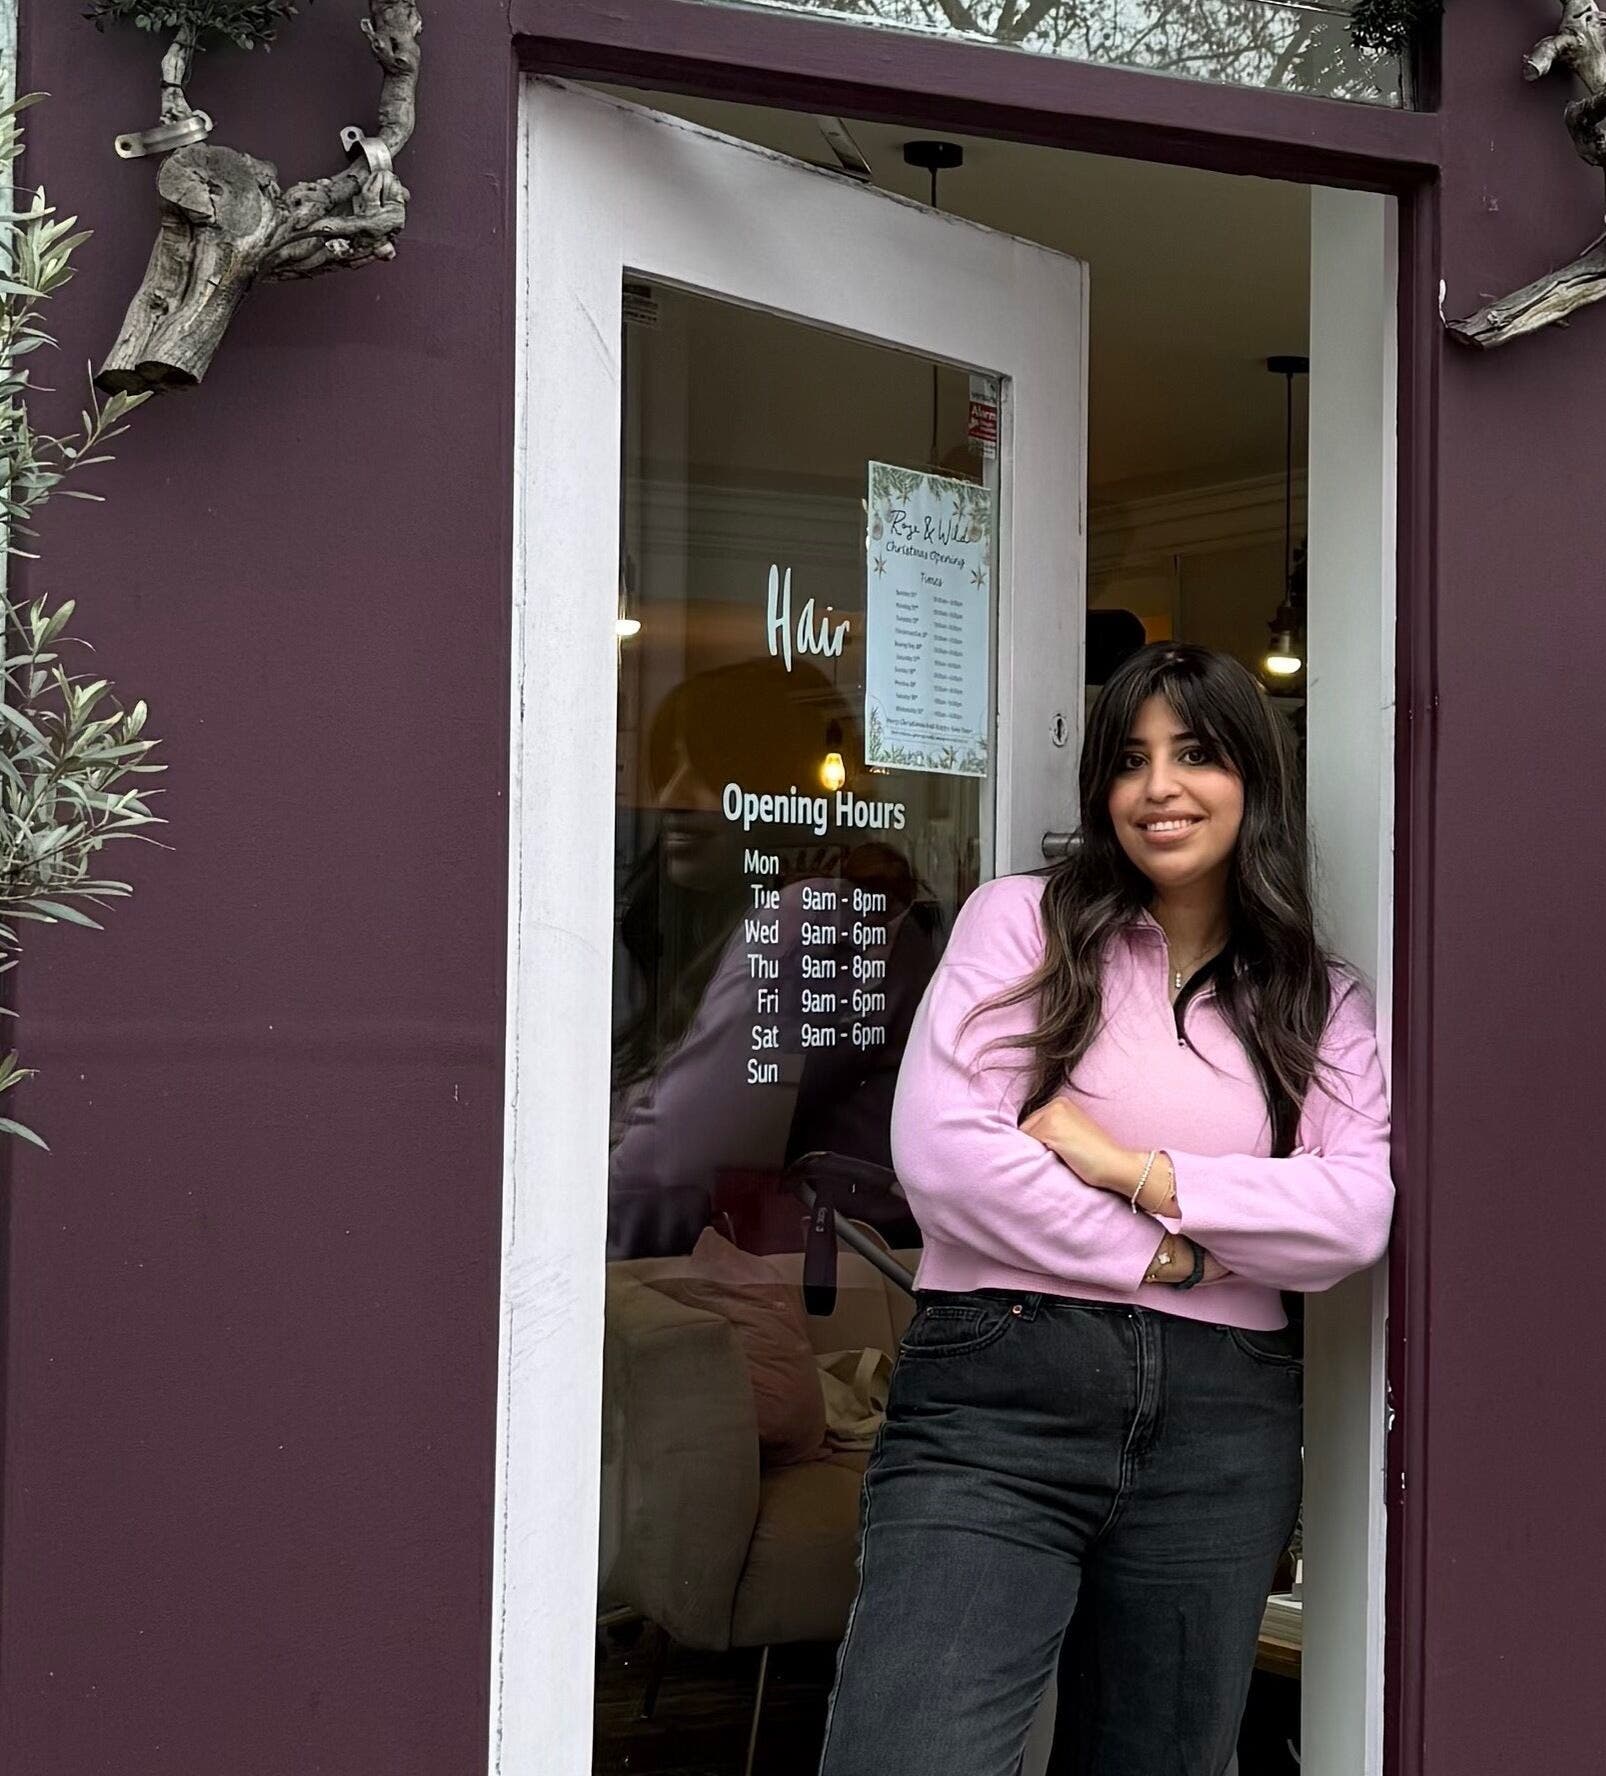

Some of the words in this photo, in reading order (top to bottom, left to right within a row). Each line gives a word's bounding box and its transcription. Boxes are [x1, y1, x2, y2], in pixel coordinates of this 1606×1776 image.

[923, 515, 936, 545] &
[886, 541, 927, 559] Christmas
[930, 551, 965, 569] Opening
[767, 563, 851, 673] Hair
[722, 782, 829, 836] Opening
[834, 789, 906, 831] Hours
[744, 848, 779, 875] Mon
[750, 884, 780, 910] Tue
[801, 886, 836, 911] 9am
[852, 886, 886, 917] 8pm
[744, 918, 779, 944] Wed
[801, 921, 836, 946] 9am
[852, 921, 886, 951] 6pm
[747, 953, 779, 979] Thu
[801, 954, 836, 979] 9am
[852, 954, 886, 984] 8pm
[757, 989, 779, 1014] Fri
[801, 989, 836, 1013] 9am
[852, 989, 886, 1018] 6pm
[751, 1026, 780, 1051] Sat
[801, 1023, 836, 1048] 9am
[852, 1023, 886, 1051] 6pm
[747, 1058, 778, 1084] Sun
